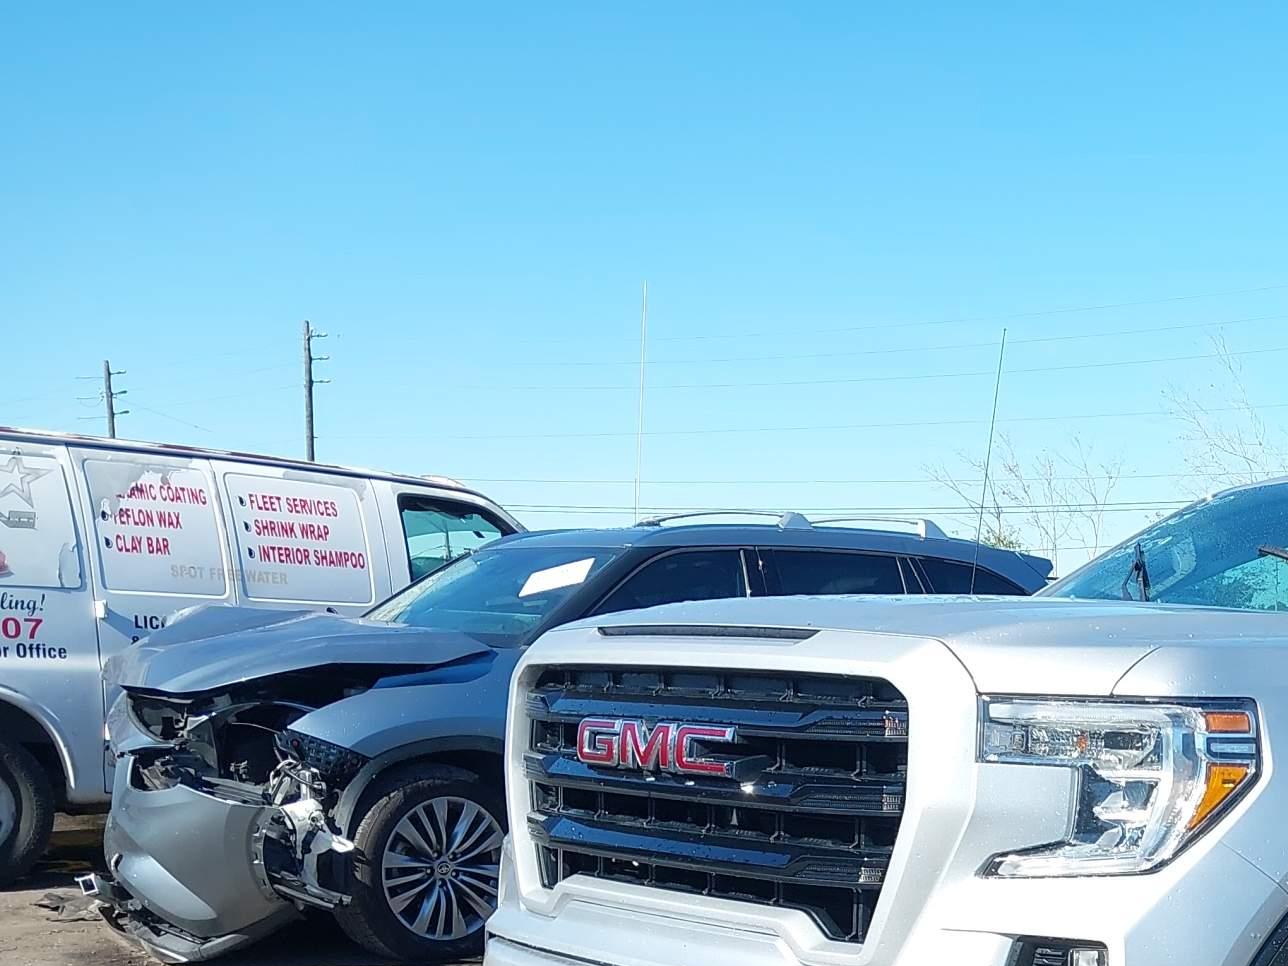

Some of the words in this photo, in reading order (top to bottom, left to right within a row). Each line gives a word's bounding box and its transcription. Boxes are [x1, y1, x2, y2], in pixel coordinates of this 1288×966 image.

[116, 482, 157, 501] AMIC
[159, 485, 207, 505] COATING
[248, 494, 282, 512] FLEET
[286, 497, 338, 517] SERVICES
[156, 511, 182, 529] WAX
[254, 519, 297, 539] SHRINK
[299, 522, 330, 541] WRAP
[115, 534, 142, 553] CLAY
[146, 536, 170, 555] BAR
[258, 545, 311, 565] INTERIOR
[314, 549, 366, 569] SHAMPOO
[170, 564, 205, 579] SPOT
[246, 570, 289, 585] WATER
[2, 617, 43, 640] 07
[0, 646, 9, 658] r
[16, 642, 68, 659] Office
[577, 716, 737, 779] GMC
